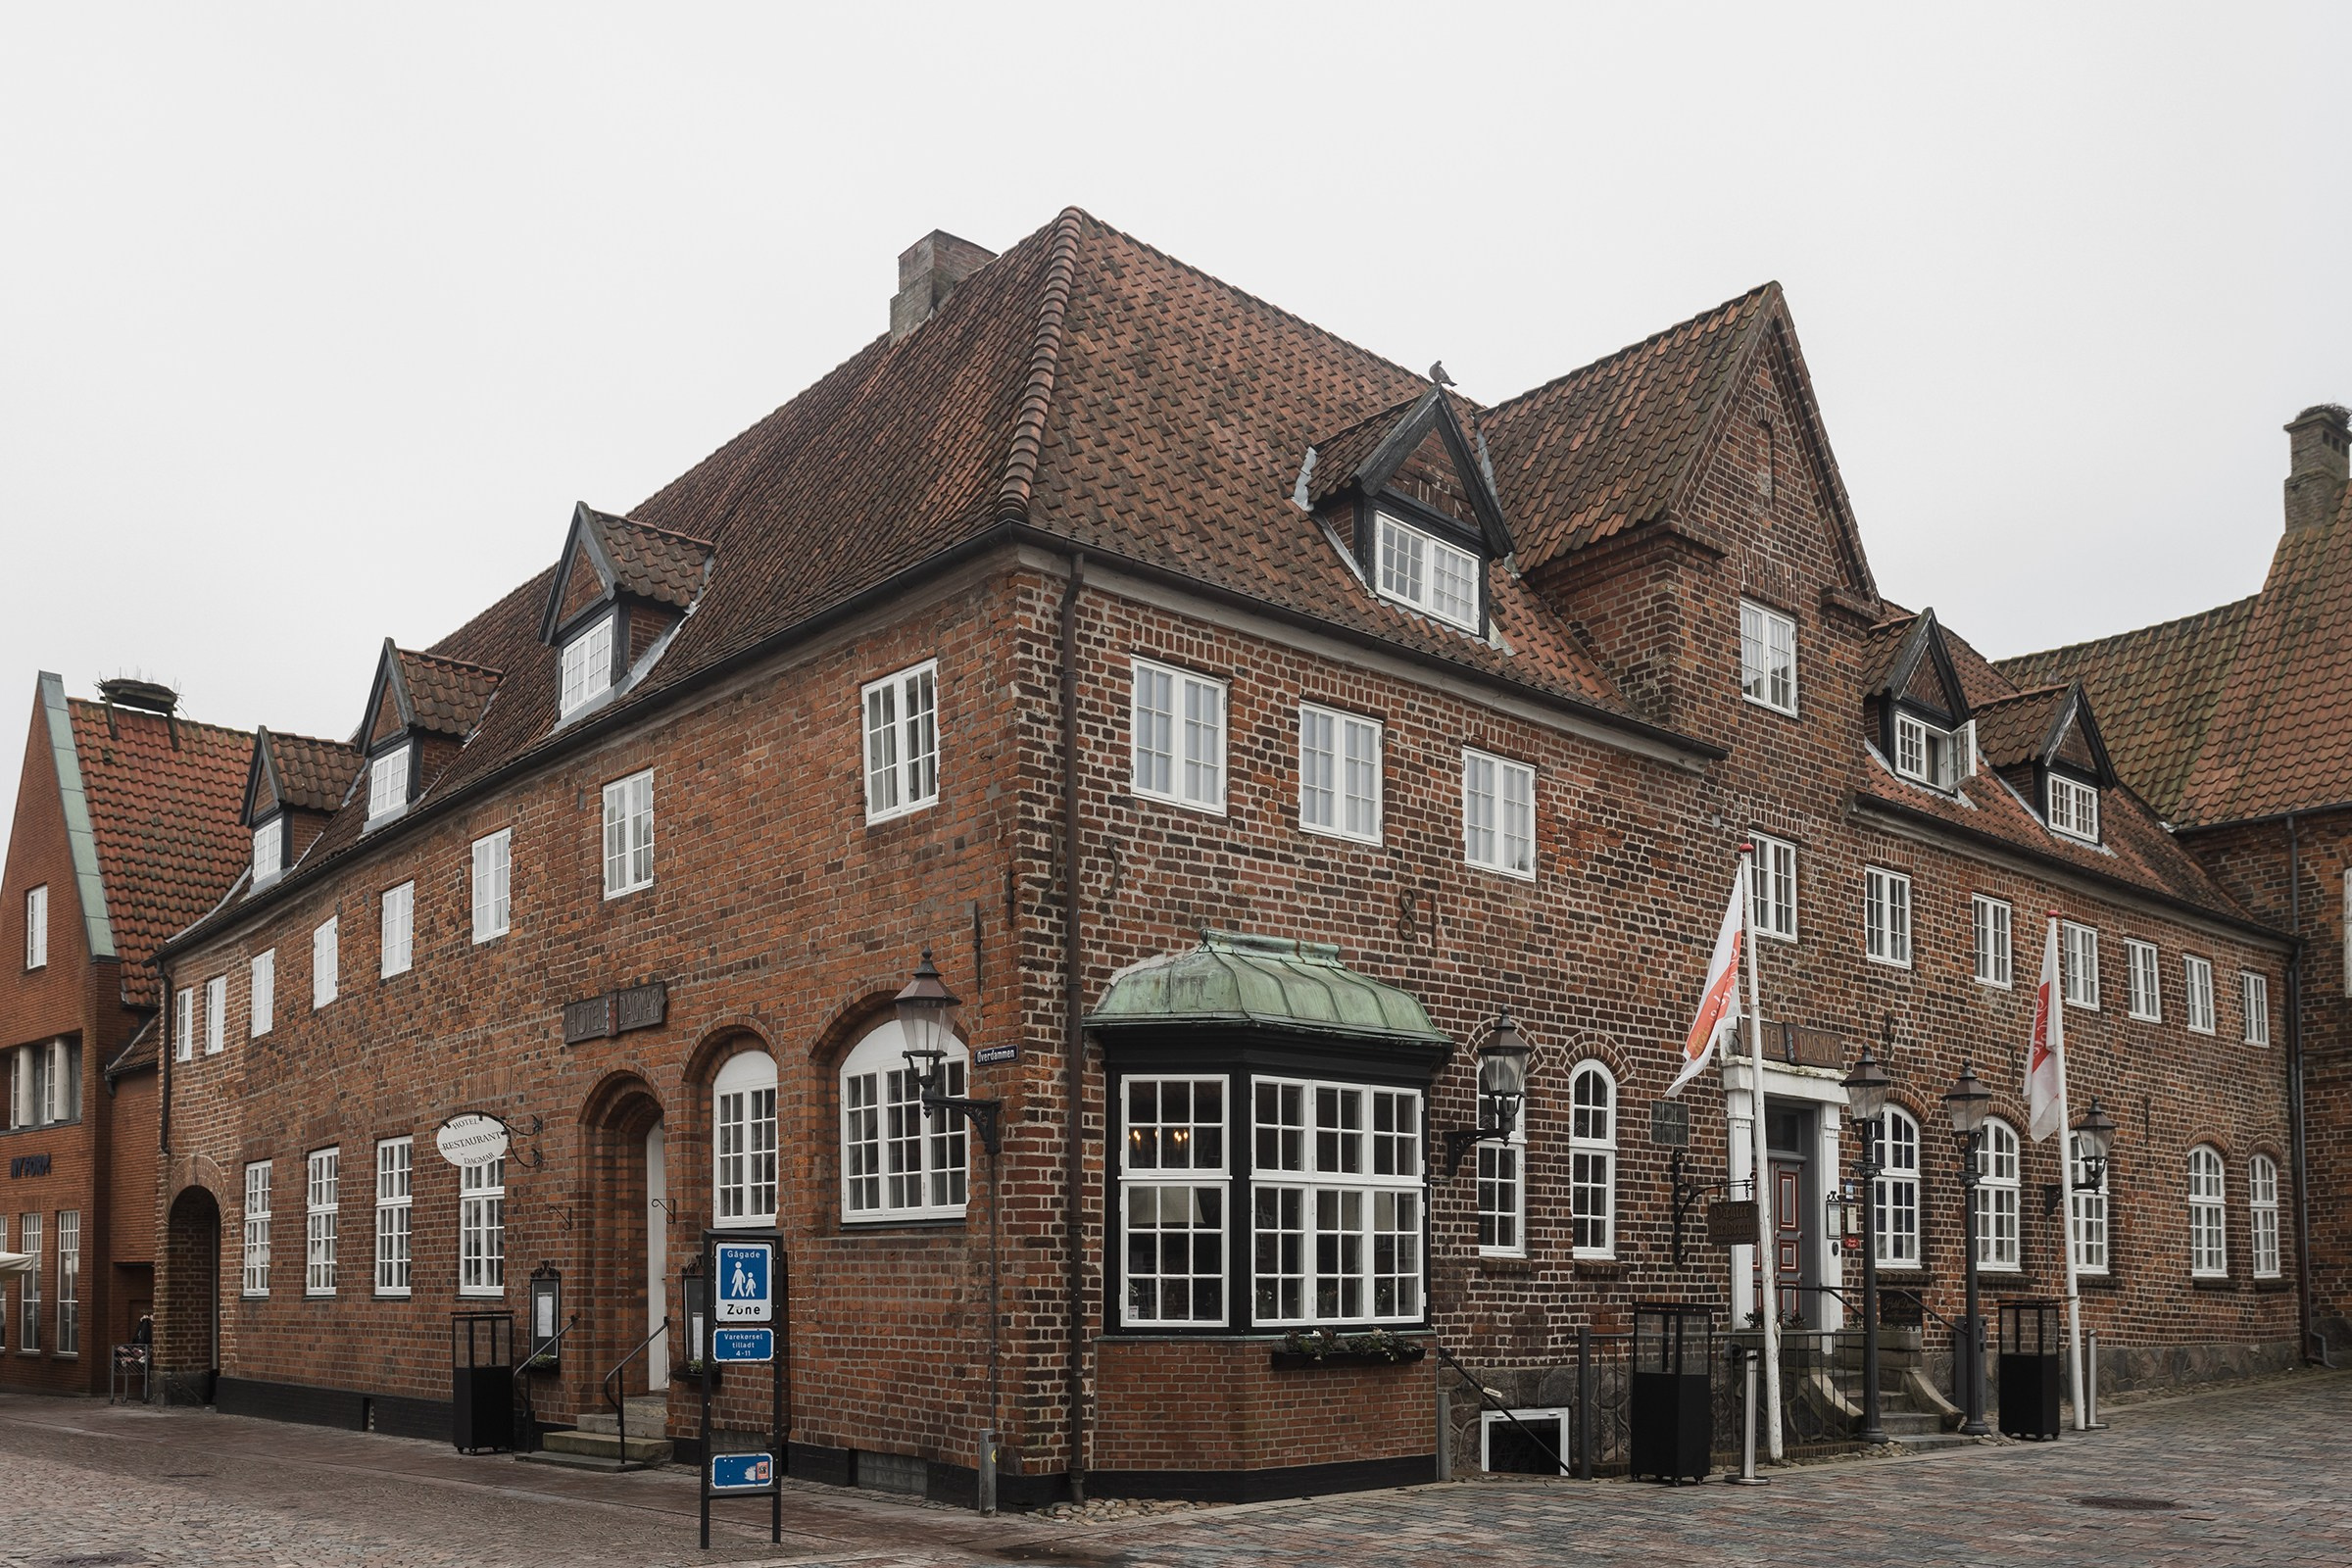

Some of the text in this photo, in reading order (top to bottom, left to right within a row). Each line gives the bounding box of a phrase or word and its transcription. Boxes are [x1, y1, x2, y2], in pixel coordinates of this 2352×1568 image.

[567, 988, 660, 1037] HOTEL DAGMAR
[1743, 1019, 1786, 1055] HTEL
[1798, 1032, 1840, 1062] DAGMAR
[976, 1049, 1015, 1063] Overdammen
[452, 1118, 479, 1130] HOTEL
[441, 1131, 502, 1151] RESTAURANT
[464, 1152, 495, 1164] DAGMAR
[727, 1250, 760, 1259] Gågade
[727, 1303, 760, 1315] Zone
